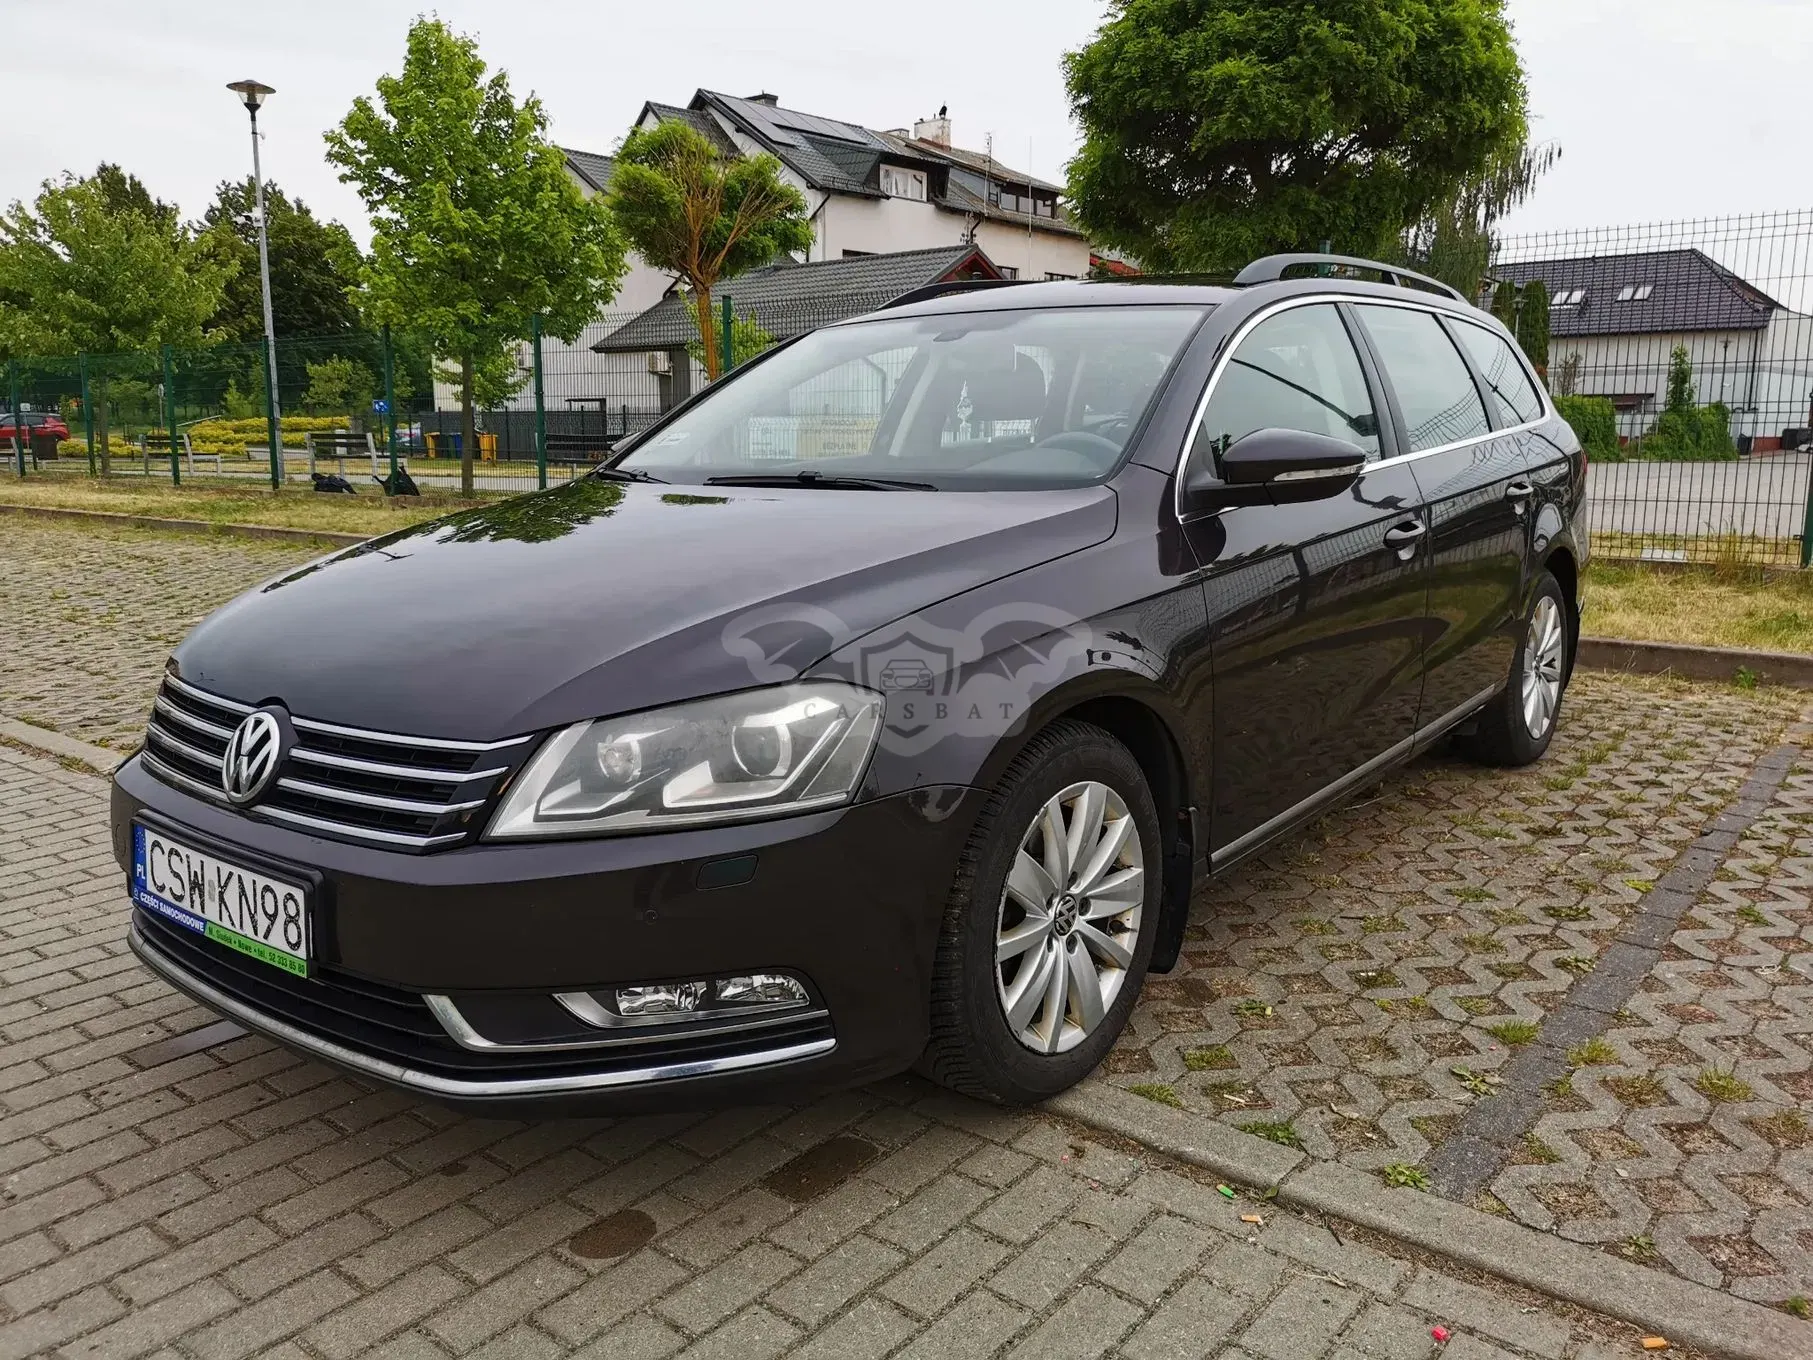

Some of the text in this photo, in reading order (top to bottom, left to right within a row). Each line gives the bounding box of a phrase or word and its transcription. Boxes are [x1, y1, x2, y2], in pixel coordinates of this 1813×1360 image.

[136, 863, 145, 880] PL
[150, 840, 302, 951] CSW KN98
[140, 892, 204, 932] CZĘŚCI SAMOCHODOWE
[269, 952, 276, 963] 52
